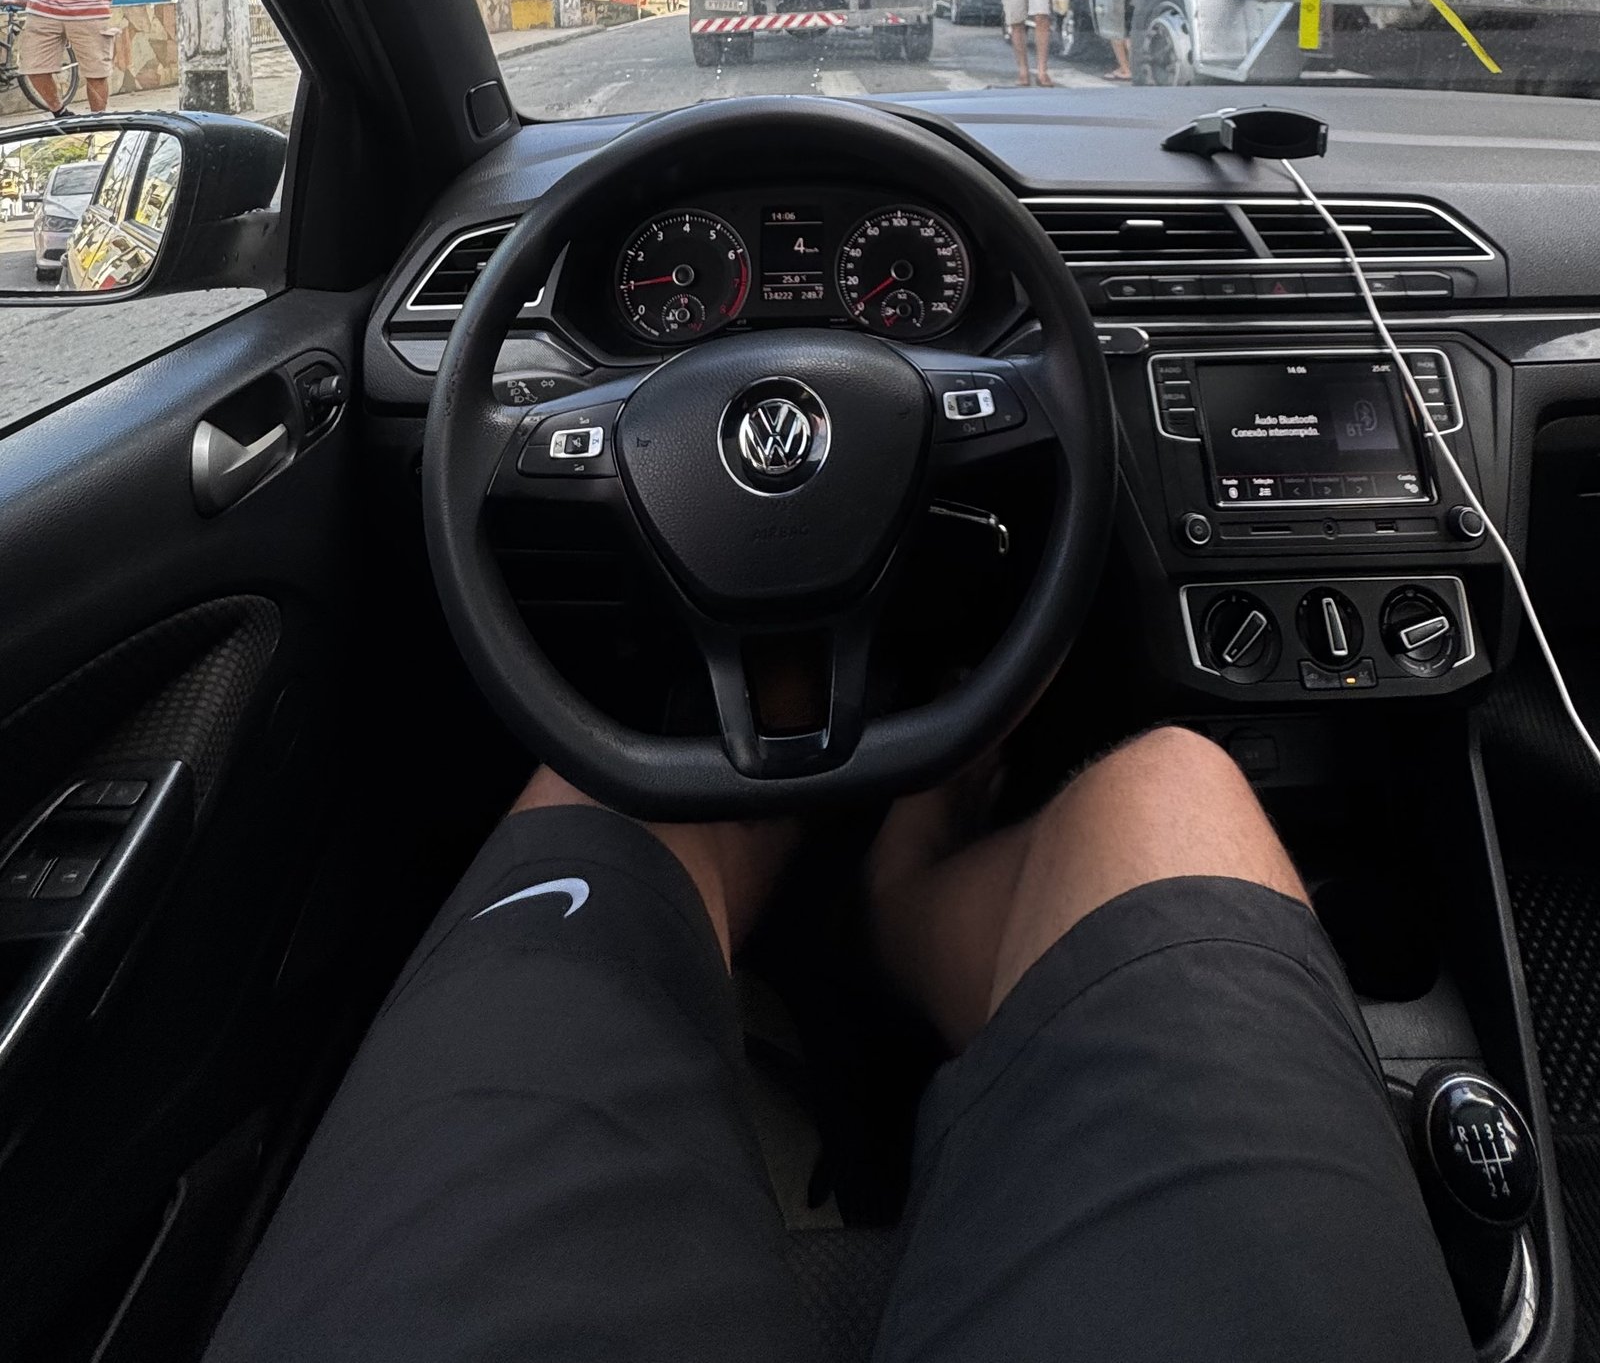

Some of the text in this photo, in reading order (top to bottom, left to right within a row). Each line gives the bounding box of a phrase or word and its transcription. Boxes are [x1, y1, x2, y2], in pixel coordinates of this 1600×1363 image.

[683, 223, 690, 233] 4
[867, 227, 879, 235] 60
[657, 231, 663, 241] 3
[709, 230, 716, 240] 5
[794, 238, 805, 254] 4
[637, 251, 644, 261] 2
[728, 250, 735, 260] 6
[850, 248, 861, 256] 40
[847, 276, 859, 285] 20
[638, 305, 645, 315] 0
[1457, 1122, 1506, 1142] R 1 3 5
[1489, 1181, 1511, 1199] 2 4
